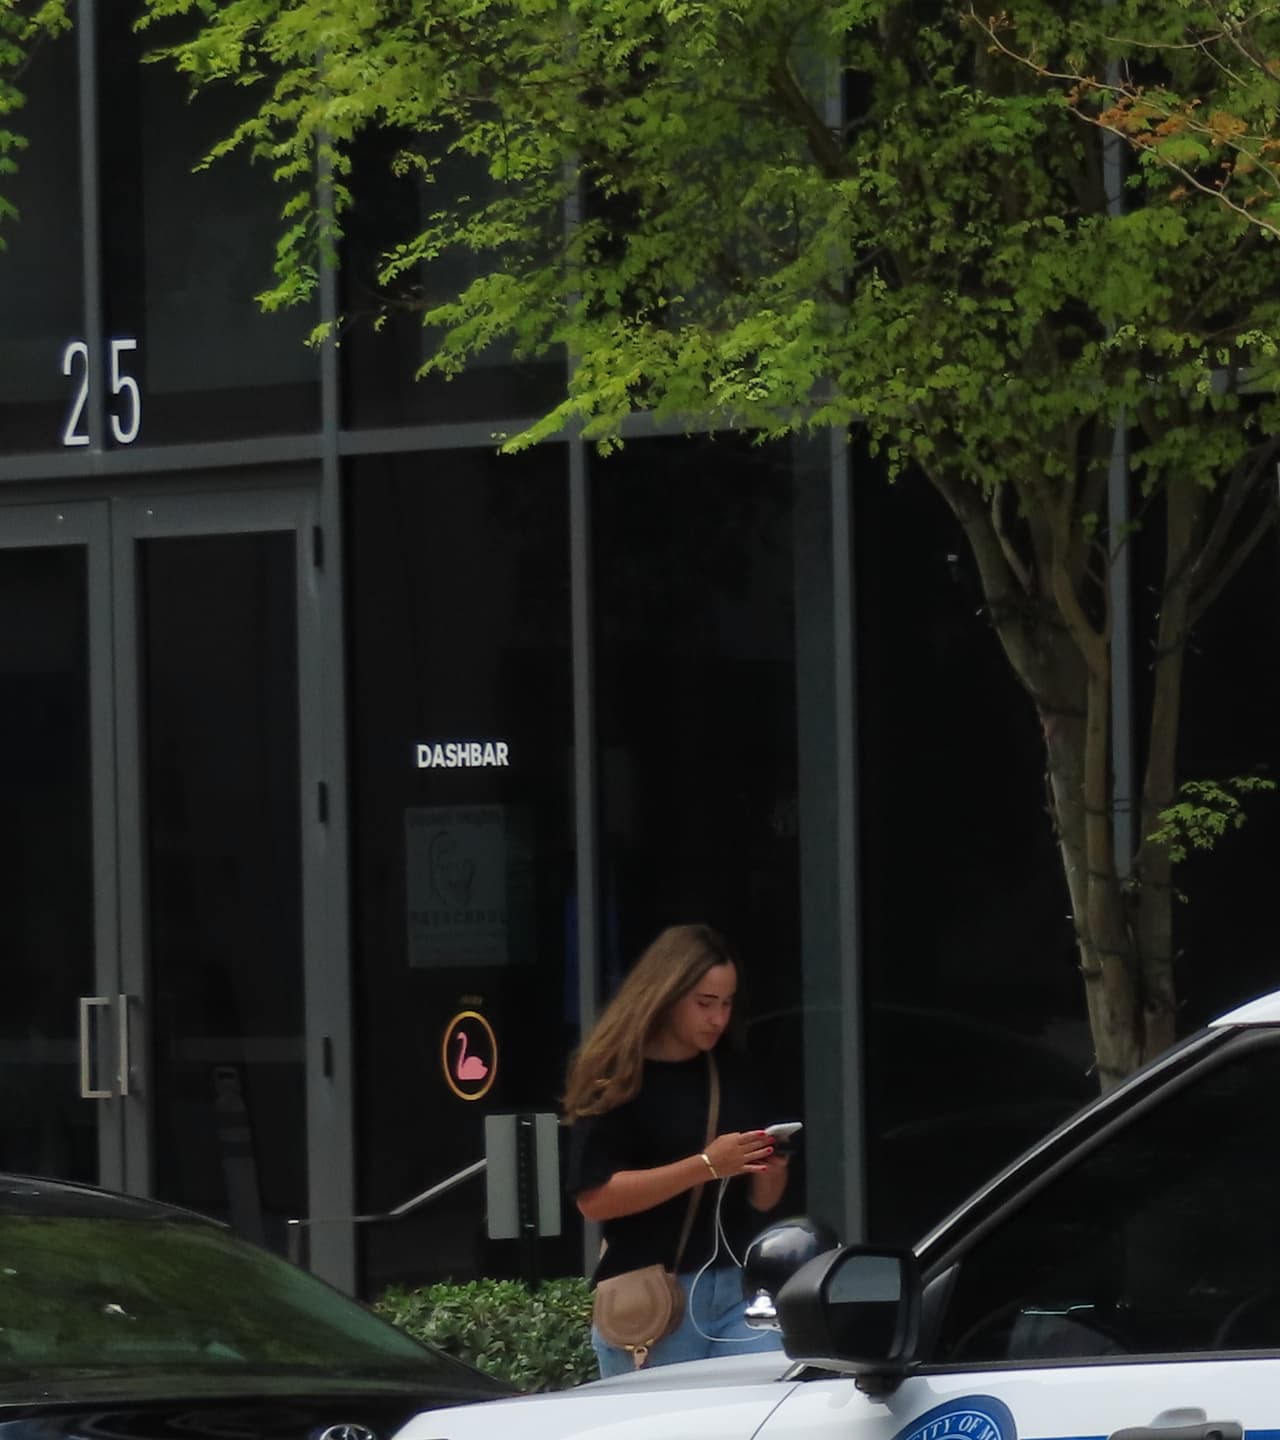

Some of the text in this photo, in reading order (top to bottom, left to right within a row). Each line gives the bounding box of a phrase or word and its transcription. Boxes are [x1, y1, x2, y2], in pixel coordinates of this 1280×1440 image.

[63, 339, 141, 446] 25
[416, 742, 511, 769] DASHBAR
[957, 1414, 979, 1434] OF
